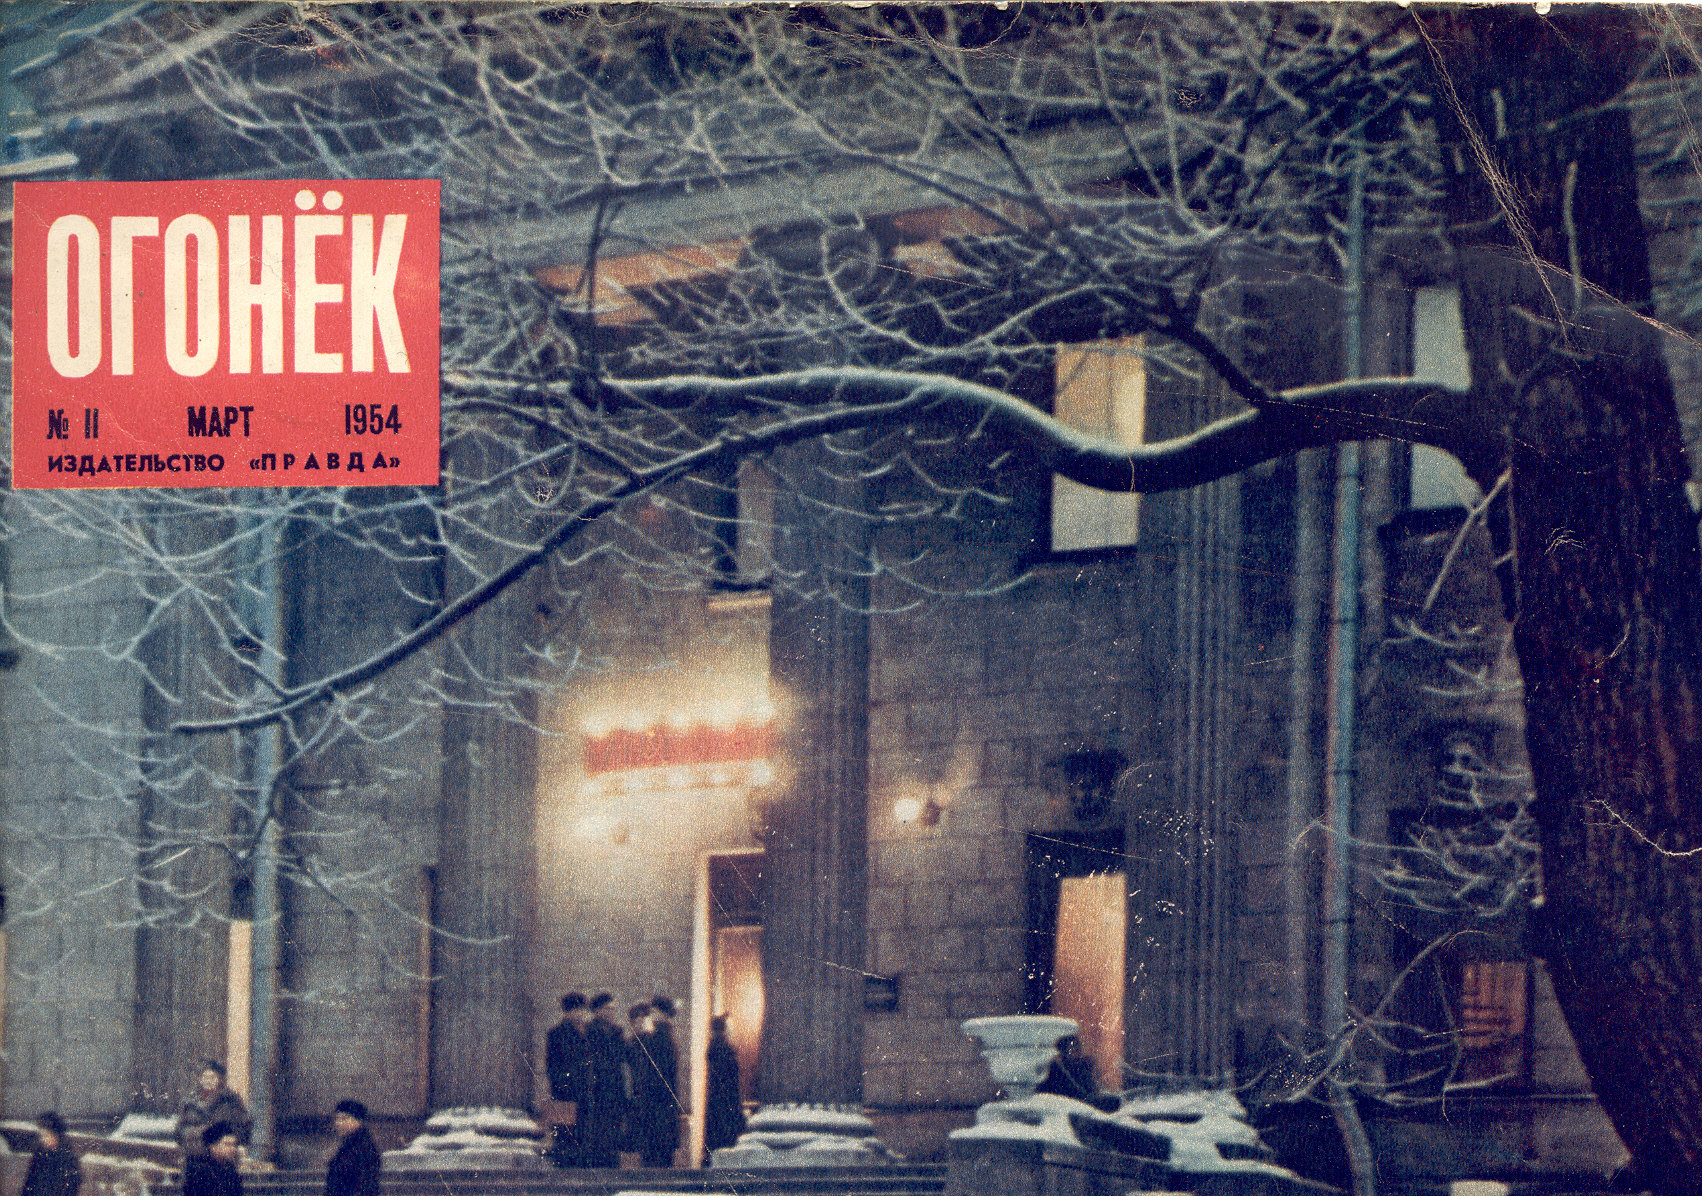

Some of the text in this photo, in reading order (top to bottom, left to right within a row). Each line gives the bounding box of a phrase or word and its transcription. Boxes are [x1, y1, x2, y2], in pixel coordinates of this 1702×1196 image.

[47, 190, 411, 378] ОГОНЁК
[187, 406, 254, 437] МАРТ
[345, 404, 402, 434] 1954
[48, 454, 225, 476] ИЗДАТЕЛЬСТВО
